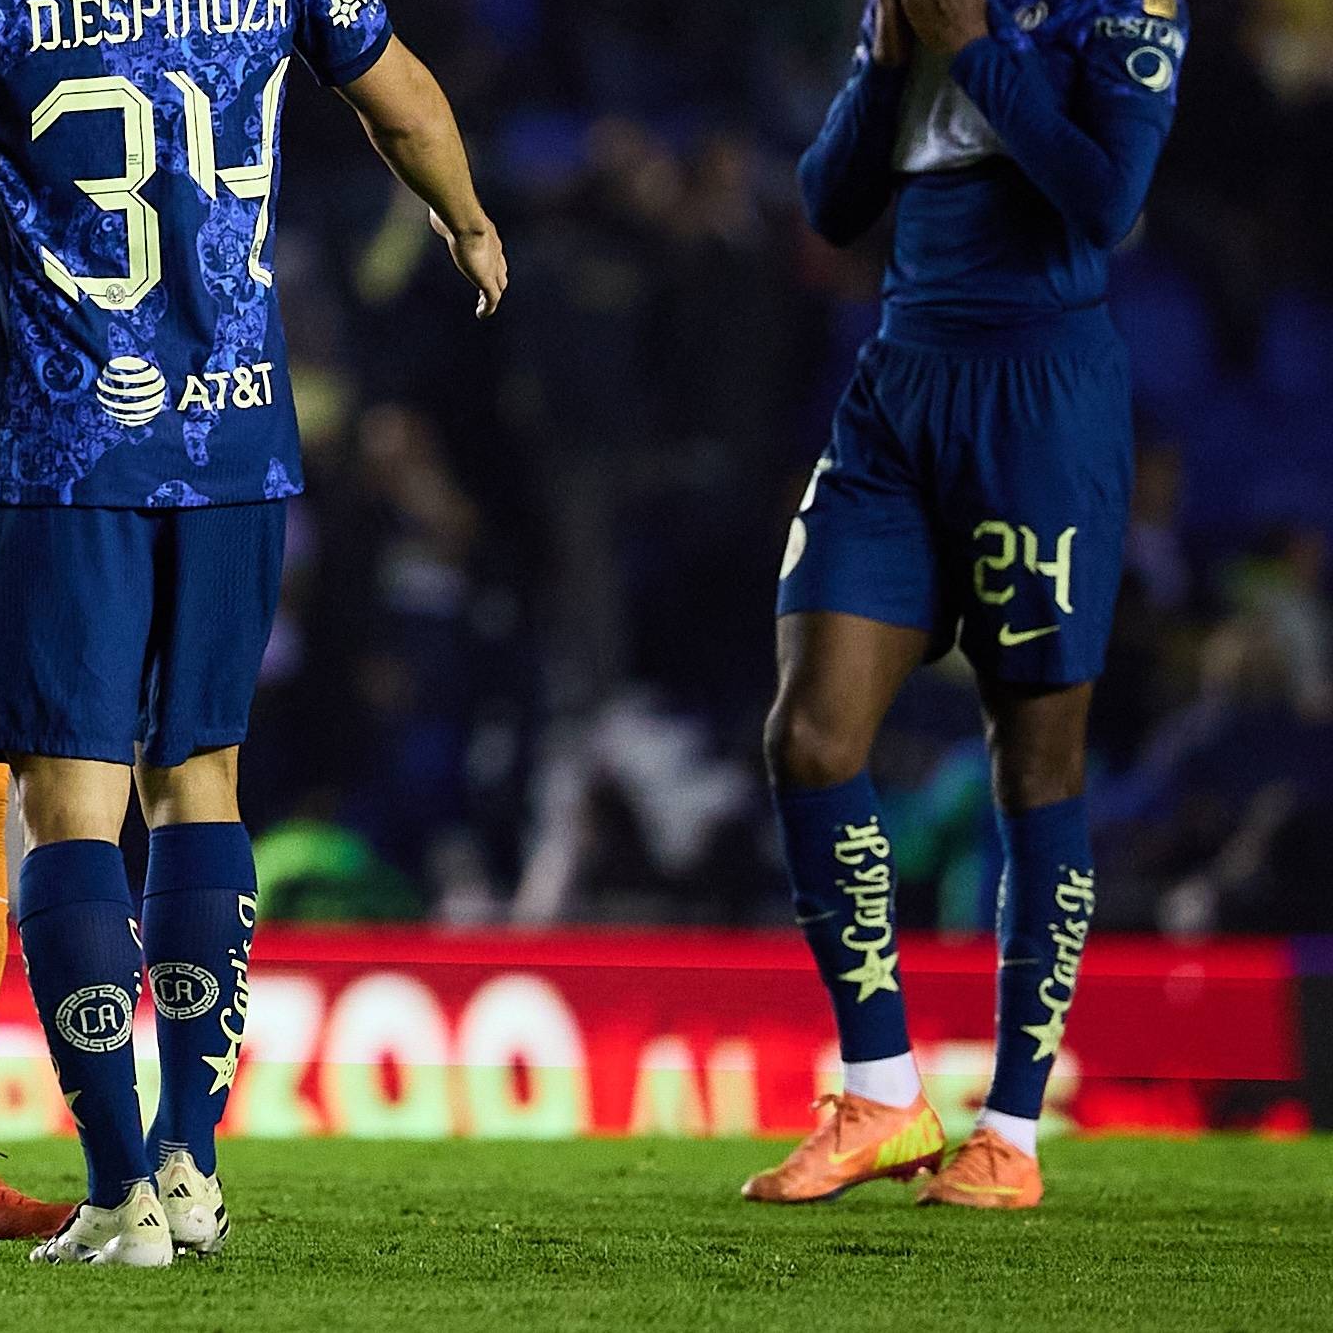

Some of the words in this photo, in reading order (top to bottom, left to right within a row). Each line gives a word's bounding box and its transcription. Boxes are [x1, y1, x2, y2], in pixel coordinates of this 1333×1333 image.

[31, 56, 291, 311] 34
[177, 363, 273, 411] AT&T
[973, 520, 1077, 614] 24
[841, 864, 893, 952] Carl's
[79, 1004, 120, 1034] CA
